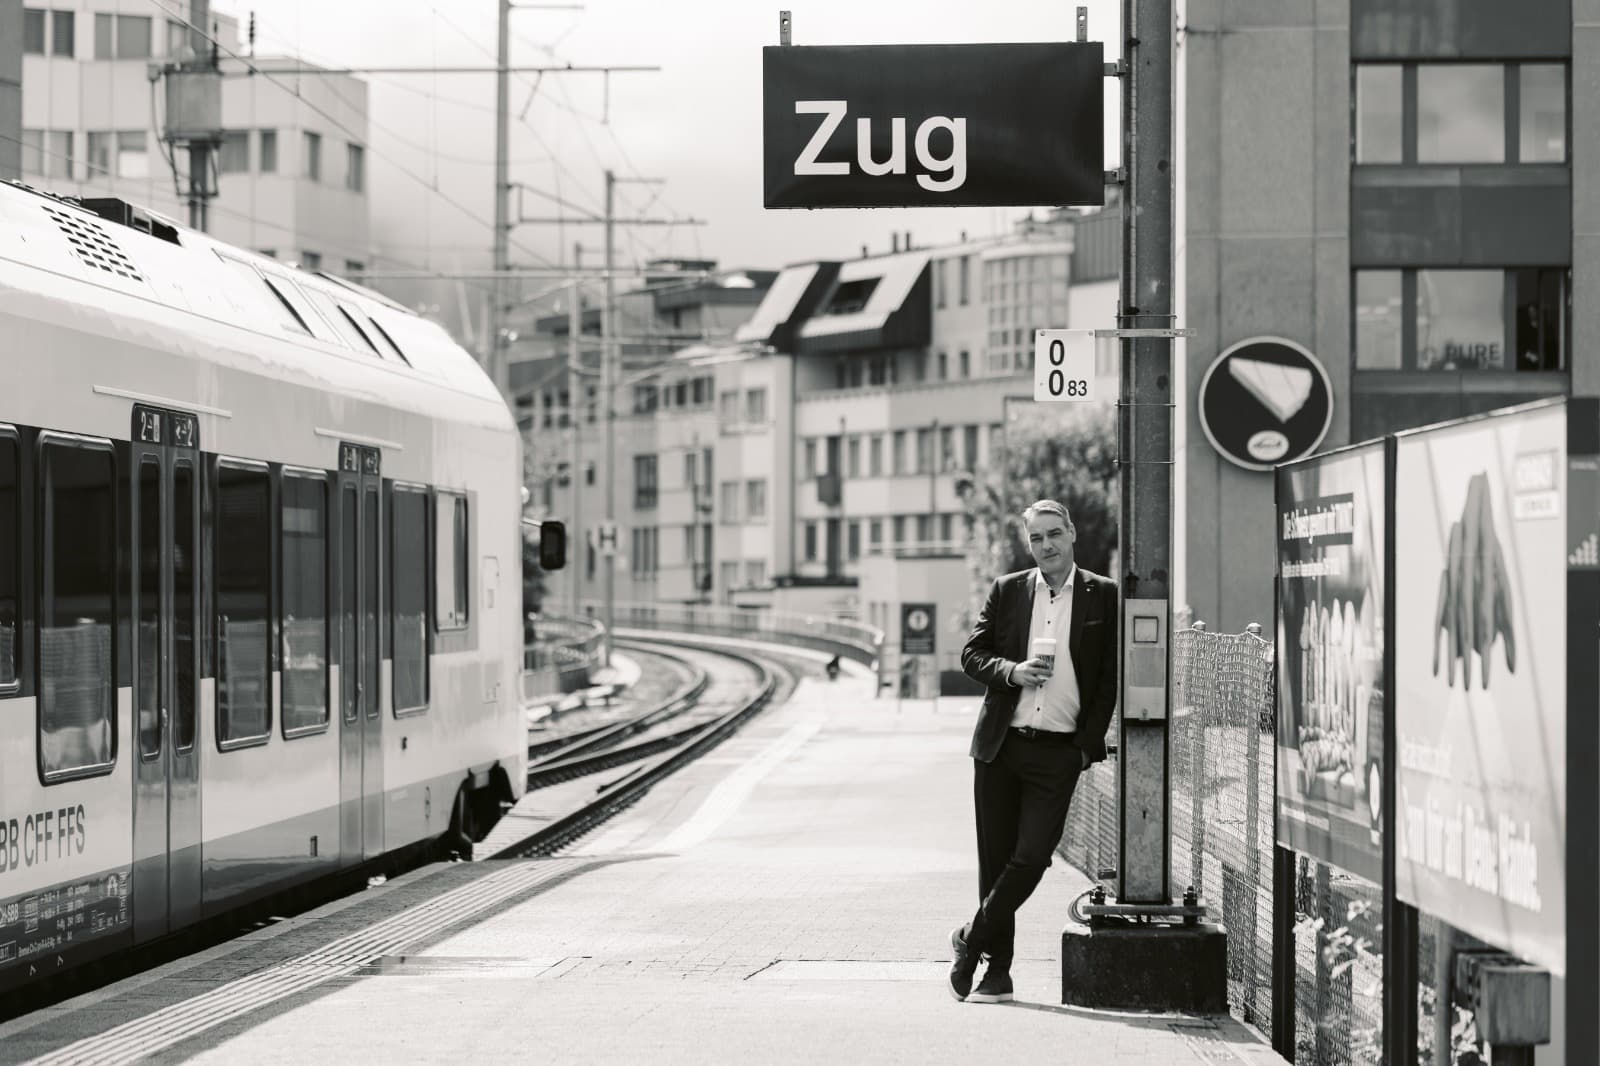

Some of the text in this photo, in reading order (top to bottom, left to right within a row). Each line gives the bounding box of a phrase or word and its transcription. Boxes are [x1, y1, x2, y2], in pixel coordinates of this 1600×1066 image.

[794, 100, 967, 192] Zug
[1049, 339, 1065, 366] 0
[24, 811, 53, 868] CFF
[58, 803, 85, 859] FFS
